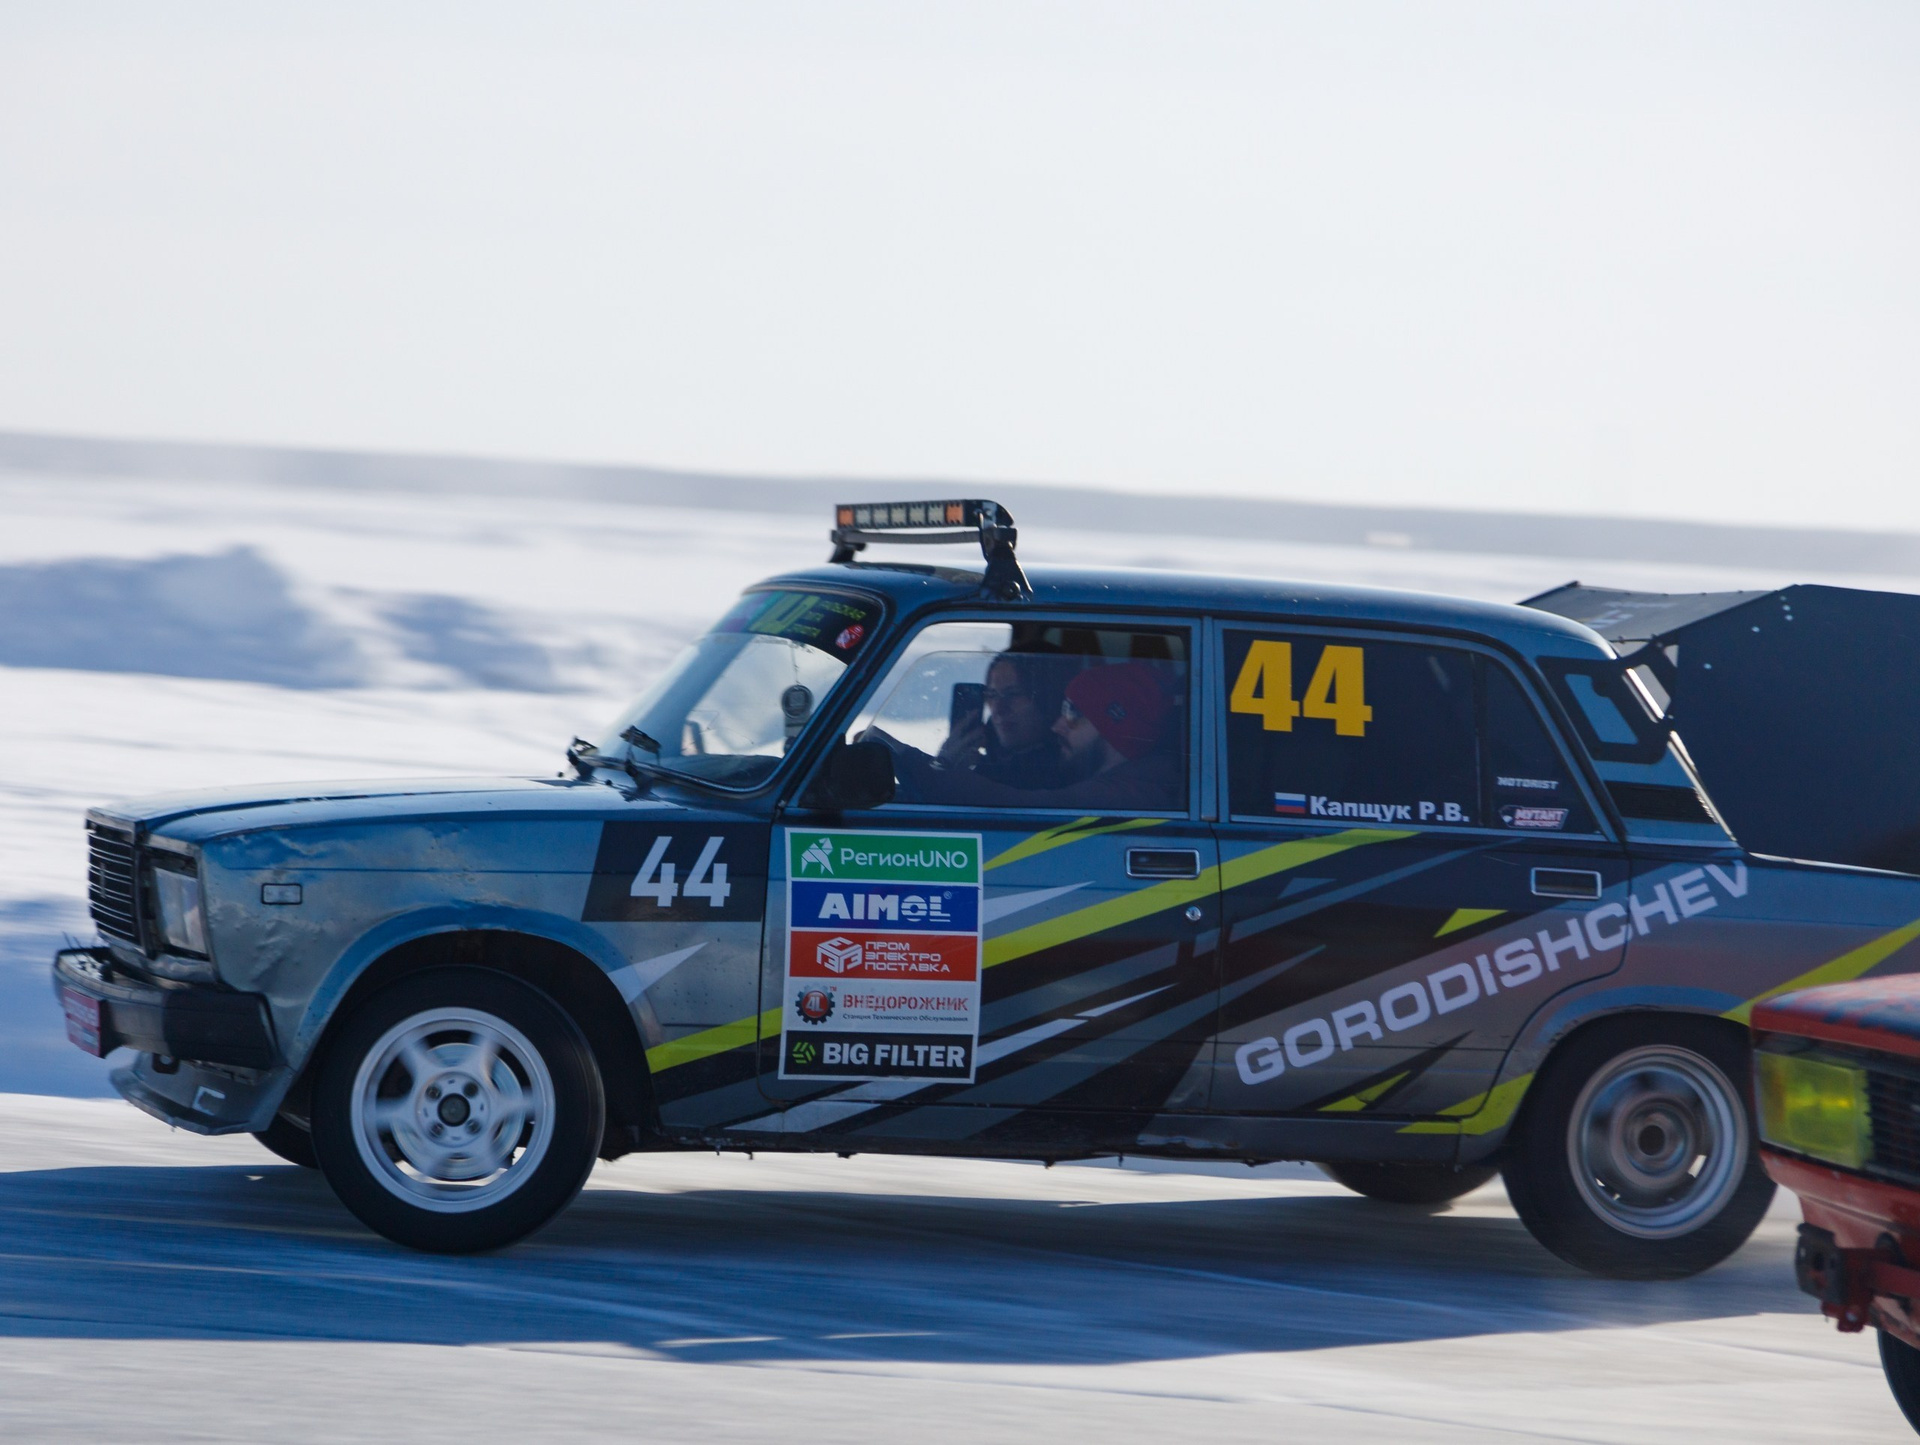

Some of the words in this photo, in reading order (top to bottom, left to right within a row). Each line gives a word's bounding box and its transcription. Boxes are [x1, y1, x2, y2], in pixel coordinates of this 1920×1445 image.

[1230, 639, 1372, 737] 44
[1310, 795, 1411, 823] Капщук
[1419, 801, 1470, 823] Р.В.
[630, 836, 731, 907] 44
[840, 848, 968, 869] РегионUNO
[818, 892, 951, 923] AIMOL
[865, 941, 910, 951] ПРОМ
[865, 951, 941, 962] ЭЛЕКТРО
[864, 962, 950, 973] ПОСТАВКА
[1234, 860, 1748, 1085] GORODISHCHEV
[843, 994, 968, 1012] ВНЕДОРОЖНИК
[822, 1042, 869, 1066] BIG
[874, 1043, 966, 1068] FILTER
